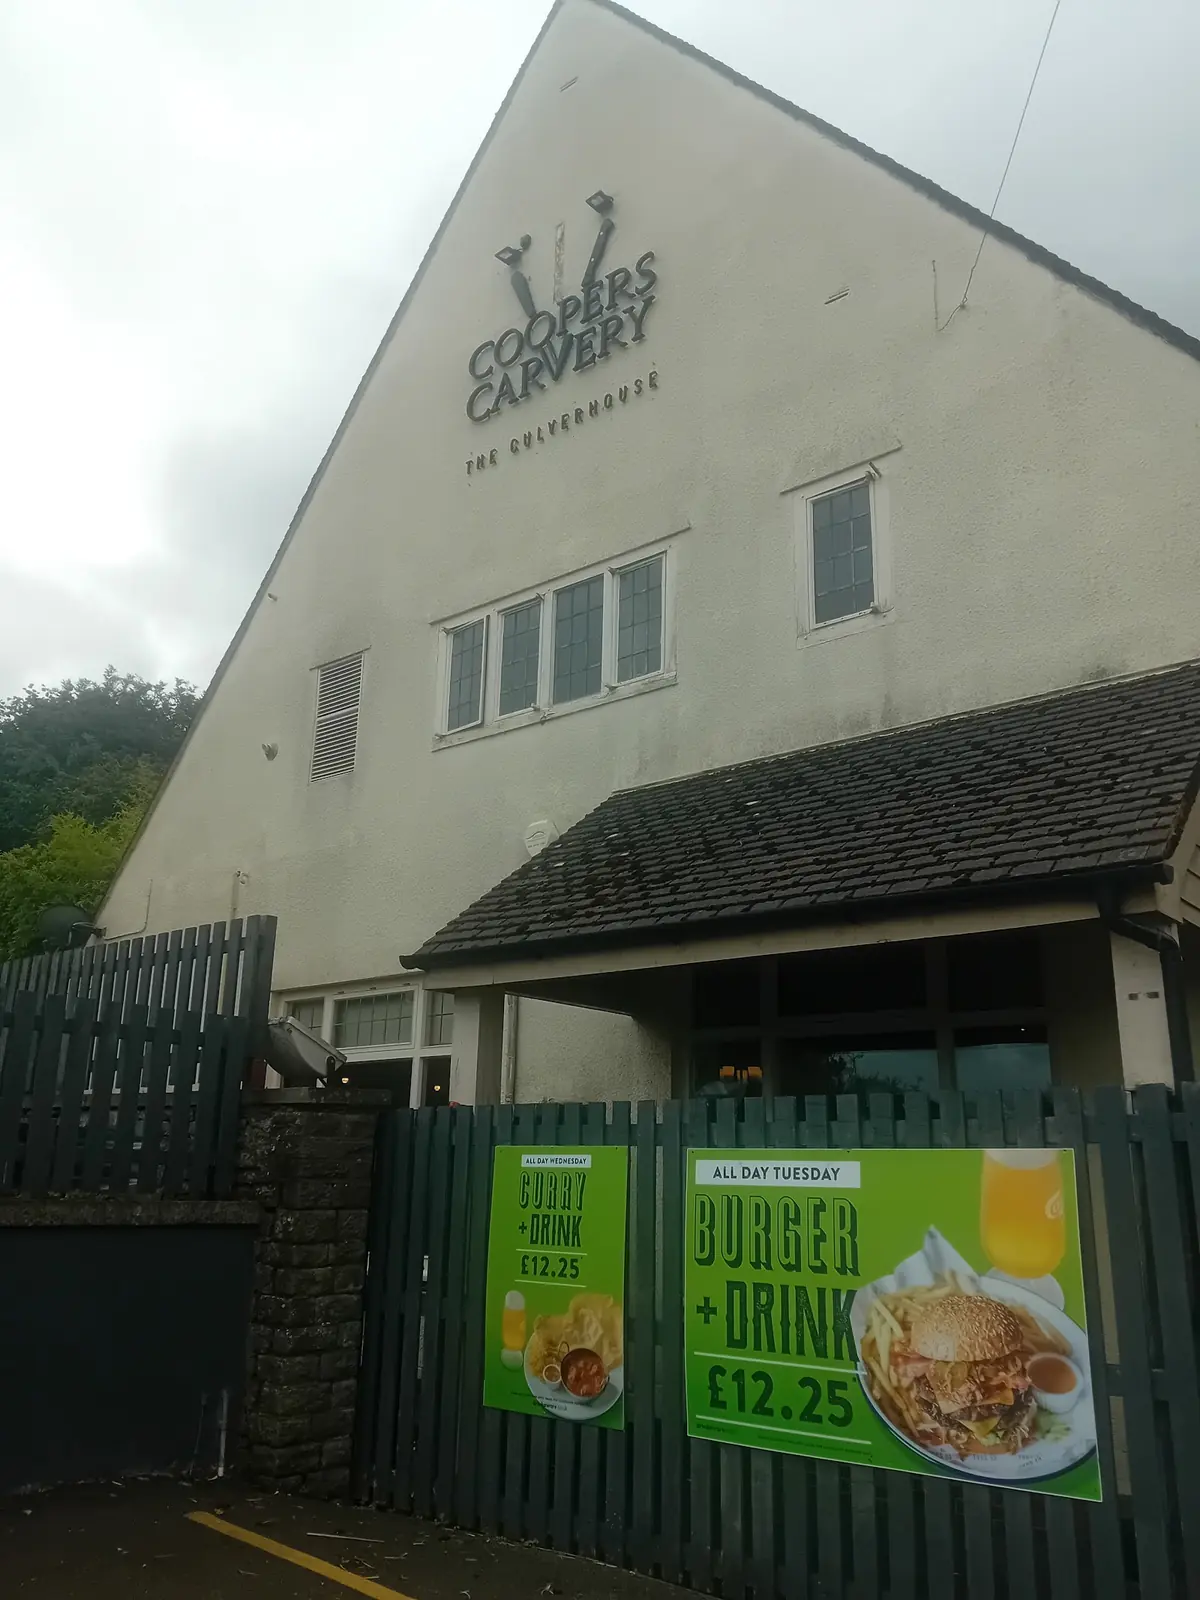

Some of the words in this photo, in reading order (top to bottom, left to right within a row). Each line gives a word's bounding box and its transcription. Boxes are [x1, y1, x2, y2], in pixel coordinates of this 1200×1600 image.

[468, 250, 658, 380] COOPERS
[466, 295, 656, 423] CARVERY
[465, 448, 498, 475] THE
[510, 370, 658, 455] CULVERHOUSE
[519, 1171, 587, 1211] CURRY
[525, 1157, 536, 1165] ALL
[537, 1157, 549, 1165] DAY
[549, 1157, 587, 1165] WEDNESDAY
[712, 1166, 738, 1180] ALL
[741, 1166, 769, 1180] DAY
[773, 1167, 841, 1181] TUESDAY
[529, 1213, 583, 1248] DRINK
[693, 1193, 861, 1277] BURGER
[521, 1254, 580, 1279] £12.25
[725, 1280, 860, 1363] DRINK
